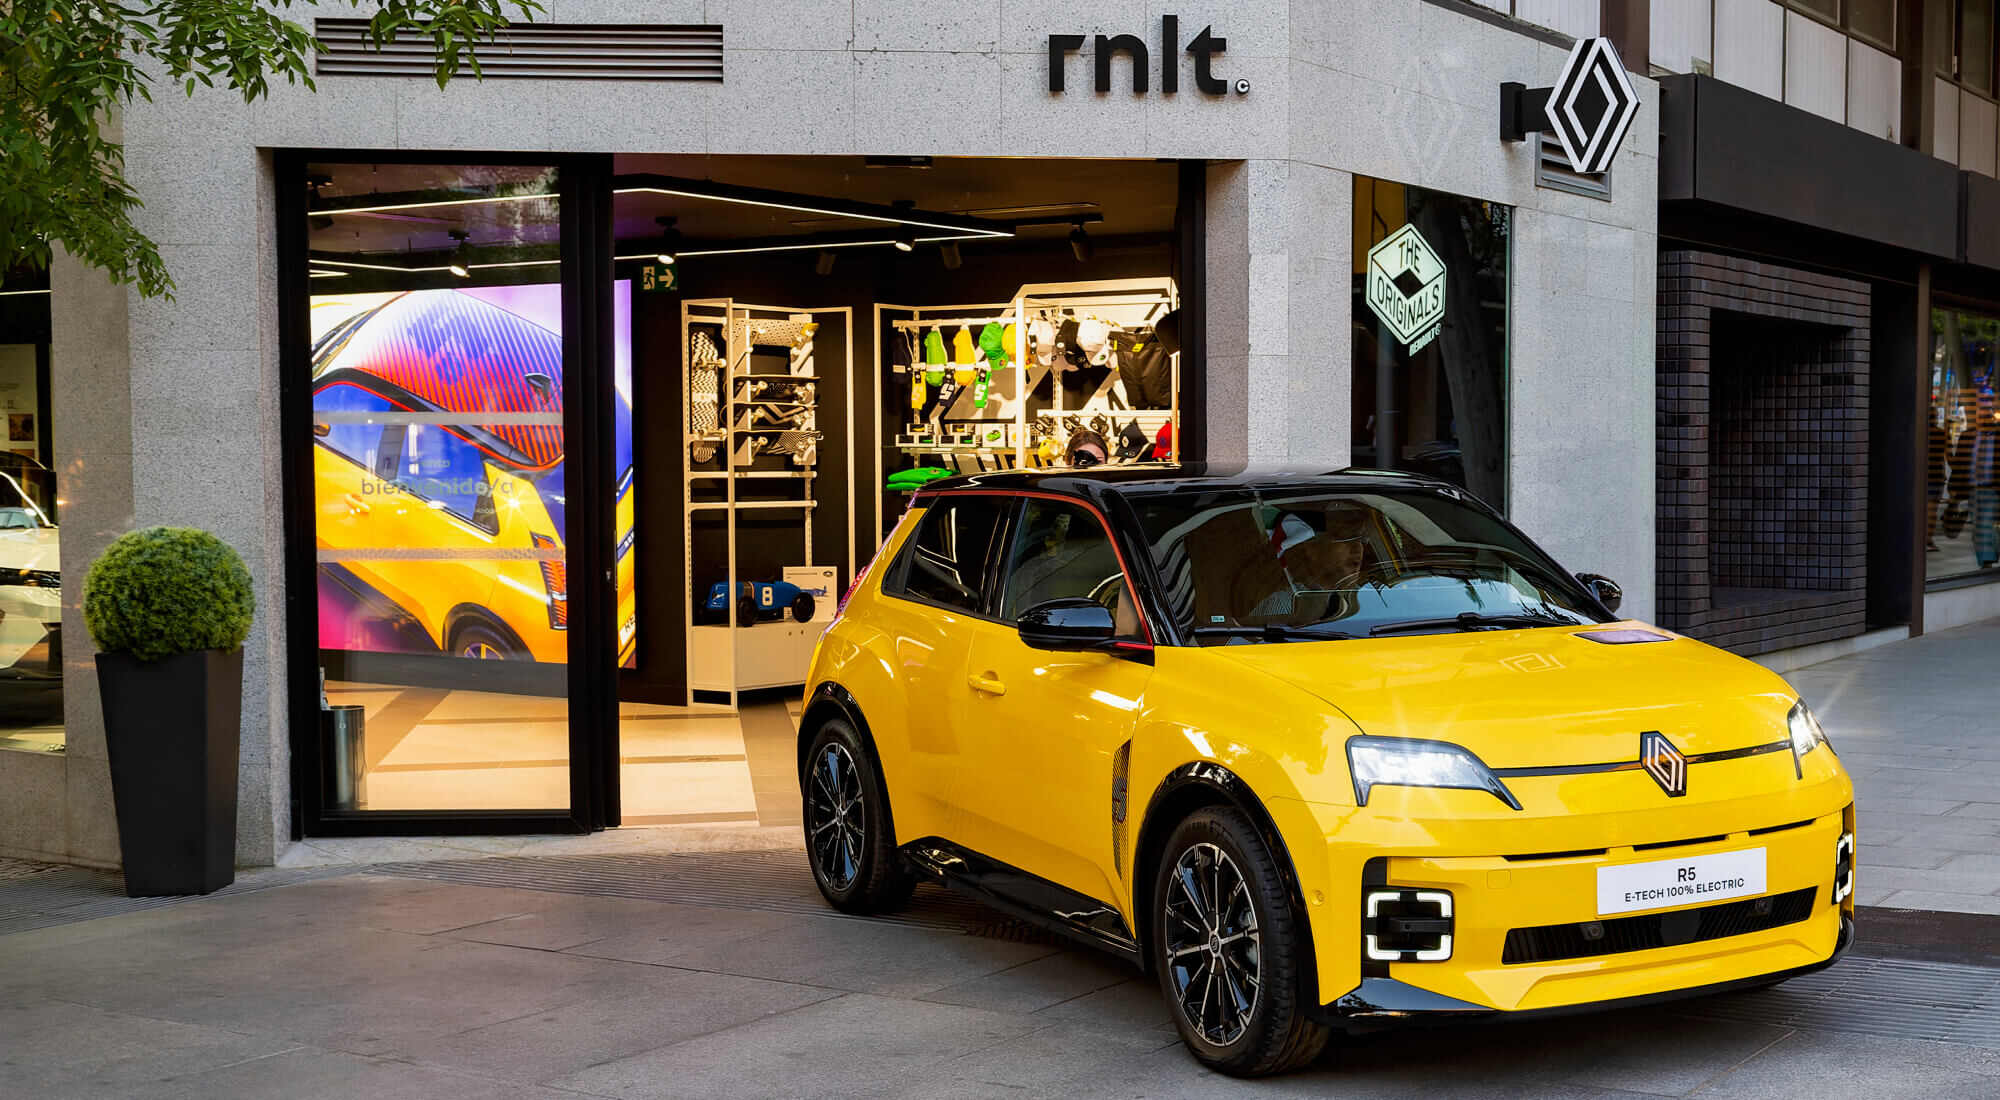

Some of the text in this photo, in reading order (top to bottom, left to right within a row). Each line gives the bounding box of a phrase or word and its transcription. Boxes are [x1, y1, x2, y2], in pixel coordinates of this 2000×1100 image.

[1398, 238, 1422, 274] THE
[1376, 275, 1441, 331] ORIGINALS
[761, 586, 774, 607] 8
[1677, 866, 1697, 883] R5
[1624, 877, 1745, 902] E-TECH 100% ELECTRIC
